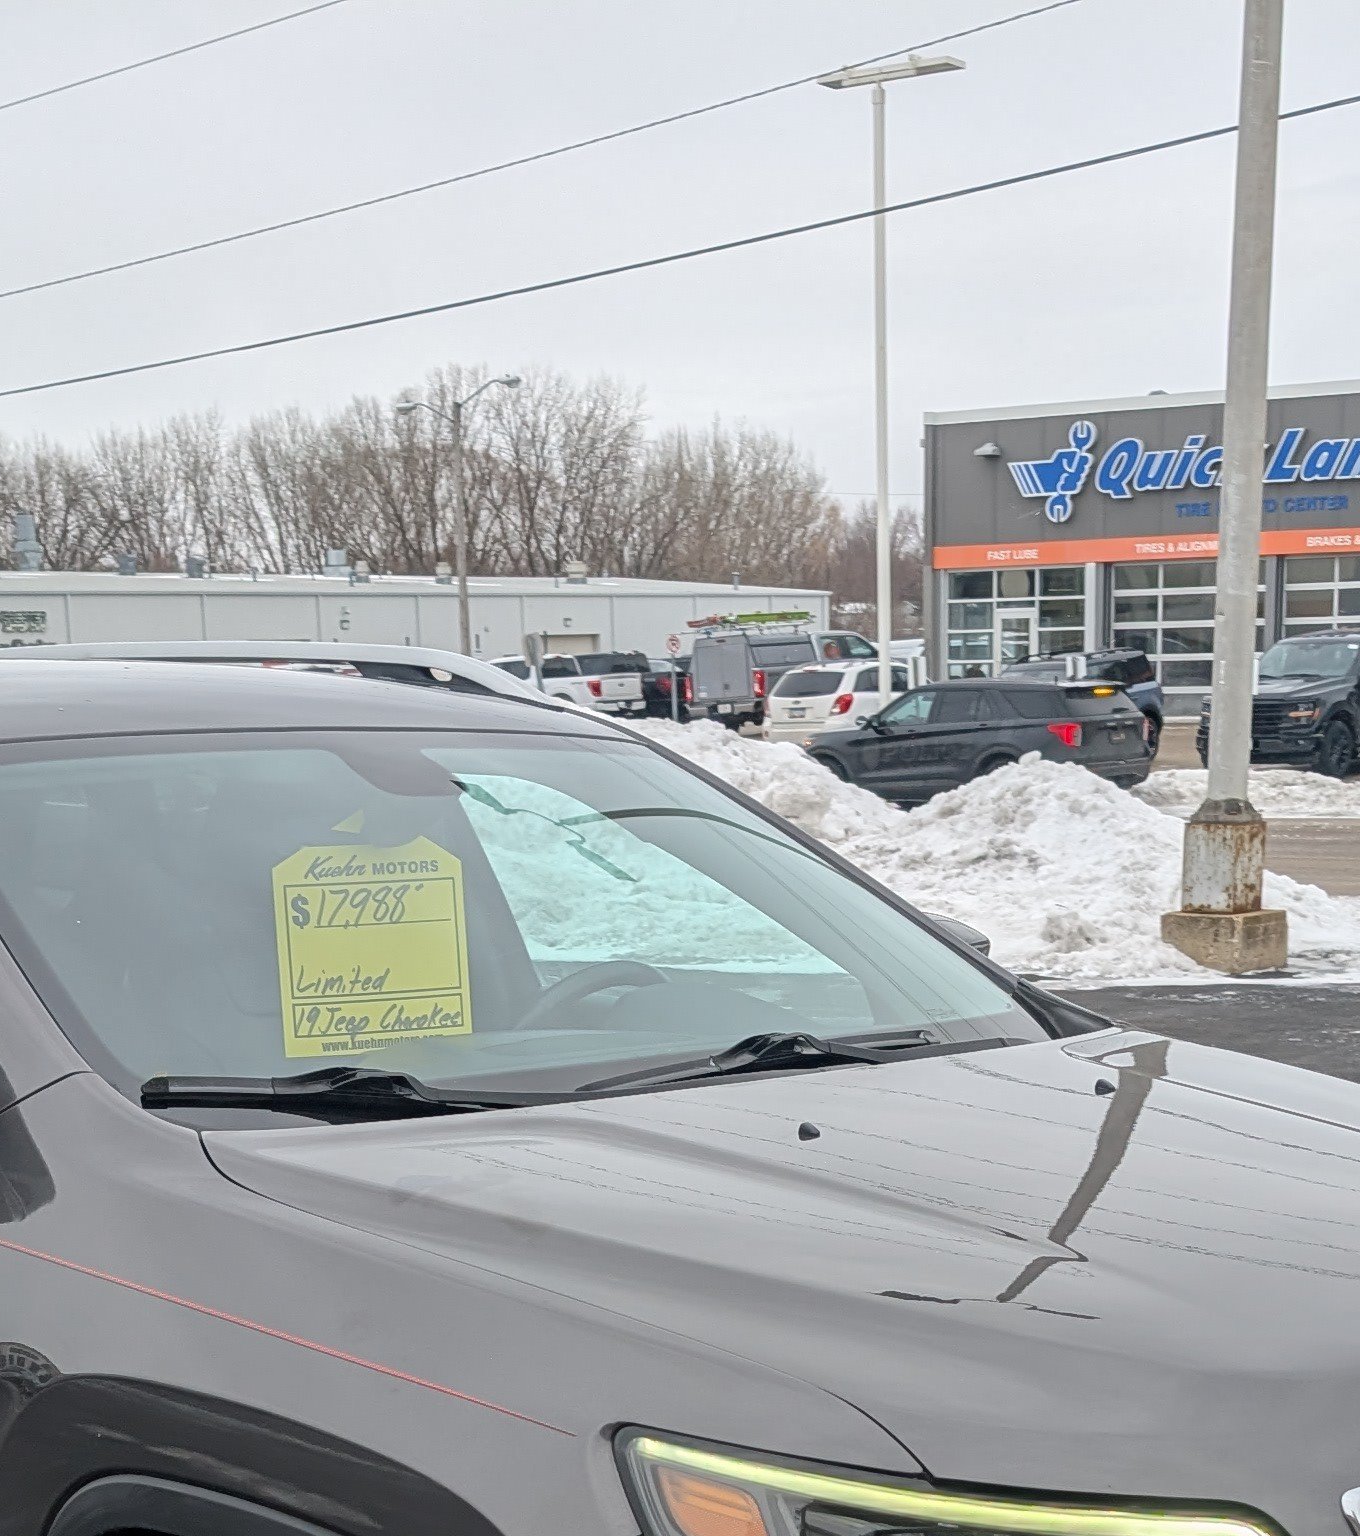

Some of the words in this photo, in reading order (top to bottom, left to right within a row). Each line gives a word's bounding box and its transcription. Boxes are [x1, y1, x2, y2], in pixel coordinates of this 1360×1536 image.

[1096, 435, 1271, 499] Quic
[1175, 502, 1211, 517] TIRE
[1283, 495, 1349, 513] CENTER
[1134, 543, 1165, 554] TIRES
[1166, 542, 1175, 552] &
[1177, 541, 1219, 552] ALIGNM
[1306, 536, 1352, 547] BRAKES
[986, 550, 1011, 560] FAST
[1013, 549, 1039, 559] LUBE
[304, 855, 368, 881] Kuehn
[372, 860, 439, 875] MOTORS
[296, 965, 391, 995] Limited
[318, 1006, 370, 1044] Jeep
[380, 1003, 461, 1031] Cherokee
